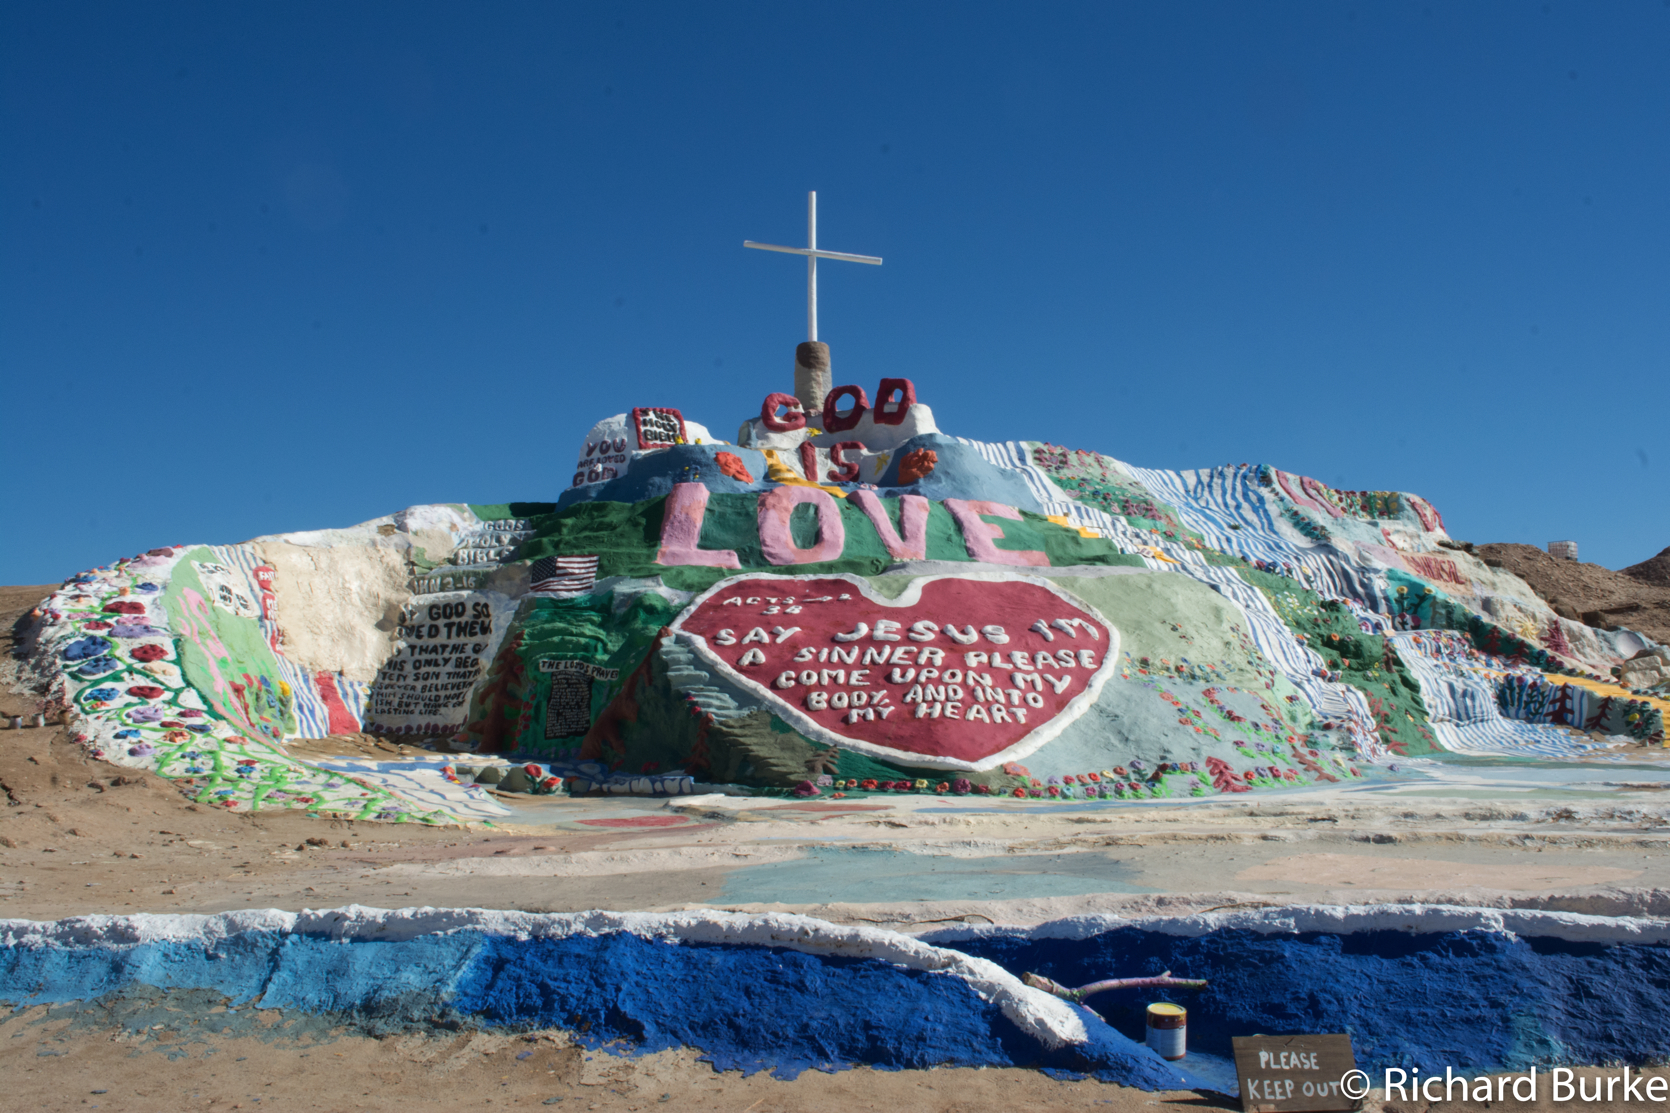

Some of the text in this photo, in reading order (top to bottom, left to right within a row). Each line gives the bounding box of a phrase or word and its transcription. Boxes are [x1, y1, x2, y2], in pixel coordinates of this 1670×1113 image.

[761, 377, 917, 434] GOD
[642, 418, 679, 434] HOLY
[586, 438, 627, 457] YOU
[596, 454, 627, 465] LOVED
[799, 441, 866, 482] IS
[572, 466, 618, 488] GOD
[654, 481, 1051, 570] LOVE
[722, 596, 796, 606] ACTS
[428, 602, 467, 621] GOD
[472, 602, 491, 620] SO
[715, 626, 802, 645] SAY
[834, 619, 1010, 644] JESUS
[408, 643, 450, 657] THAT
[738, 645, 1098, 670] A SINNER PLEASE
[412, 657, 452, 670] ONLY
[541, 661, 562, 670] THE
[413, 670, 440, 680] SON
[776, 667, 1072, 695] COME UPON MY
[397, 700, 420, 708] BUT
[398, 691, 441, 702] SHOULD
[902, 683, 964, 704] AND
[973, 685, 1044, 709] INTO
[374, 708, 415, 716] LASTING
[848, 702, 1028, 724] MY HEART
[1259, 1051, 1320, 1069] PLEASE
[1247, 1078, 1341, 1100] KEEP OUT
